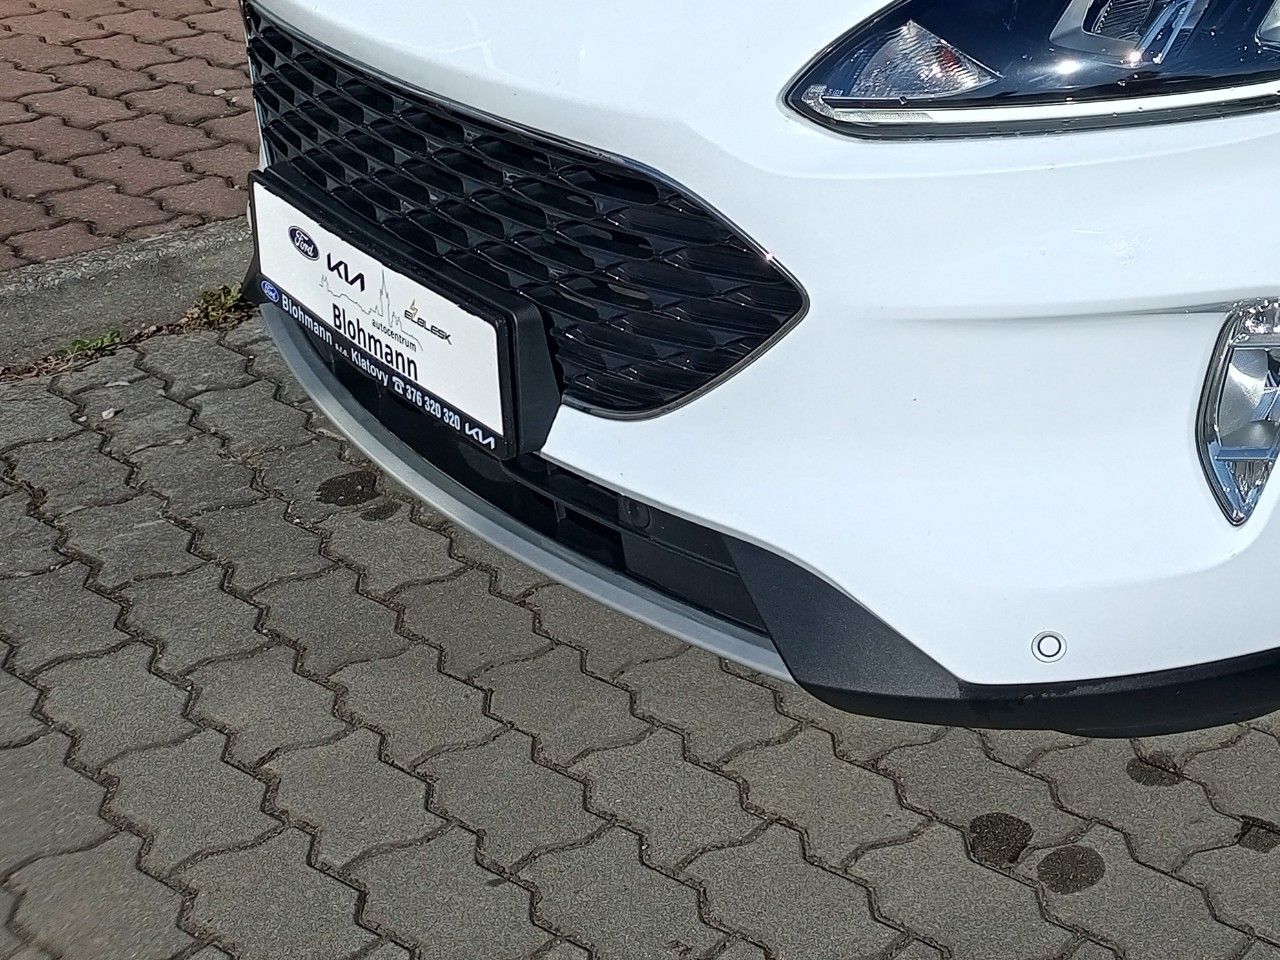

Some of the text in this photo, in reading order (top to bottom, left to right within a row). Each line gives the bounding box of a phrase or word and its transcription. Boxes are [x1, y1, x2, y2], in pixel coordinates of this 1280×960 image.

[281, 294, 333, 345] Blohmann
[350, 348, 389, 386] Klatovy
[406, 385, 422, 406] 376
[424, 396, 441, 418] 320
[443, 408, 461, 431] 320
[332, 303, 418, 381] Blohmann
[372, 319, 417, 353] autocentrum
